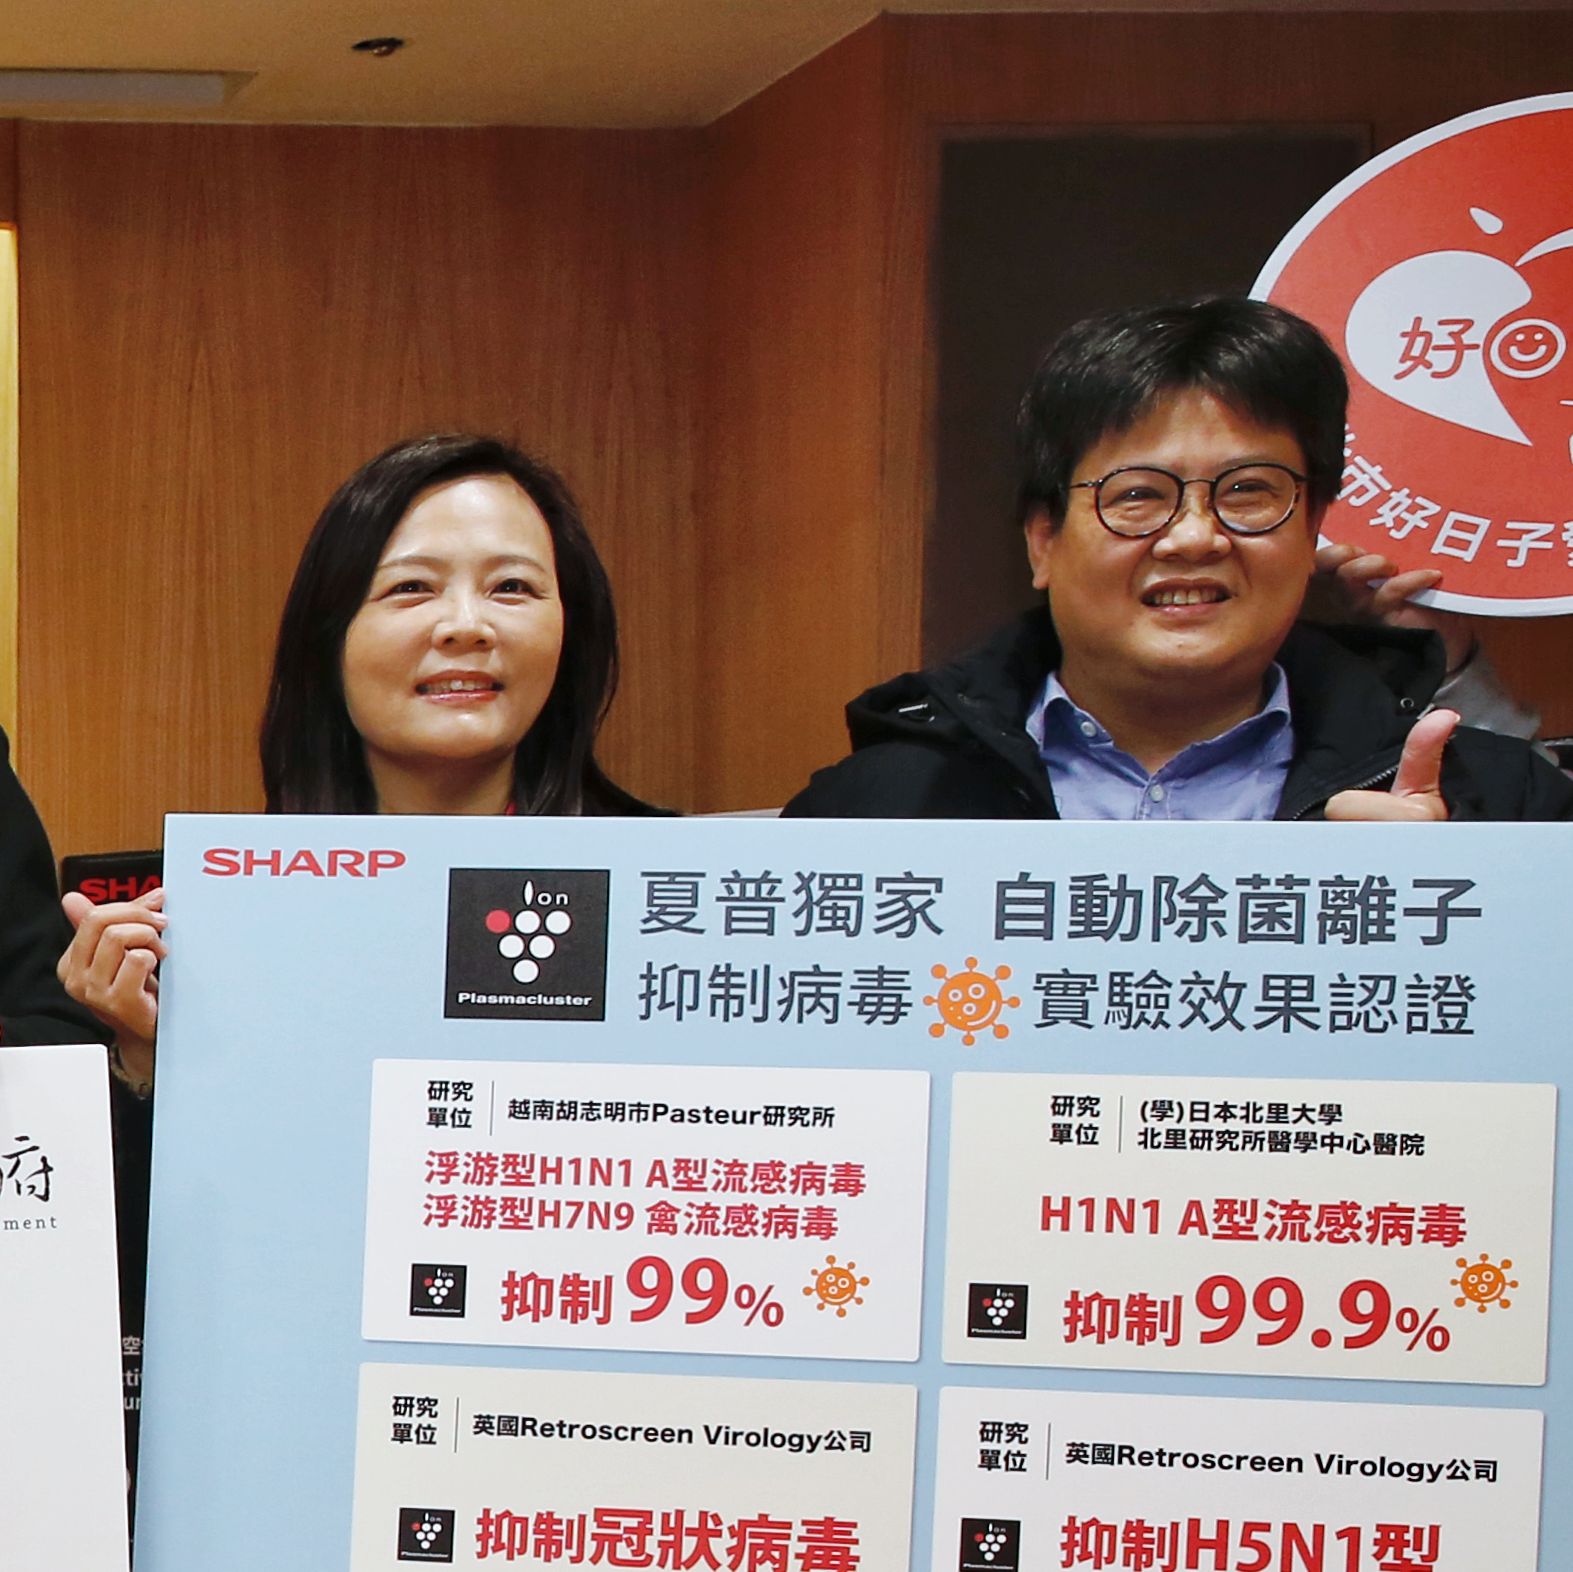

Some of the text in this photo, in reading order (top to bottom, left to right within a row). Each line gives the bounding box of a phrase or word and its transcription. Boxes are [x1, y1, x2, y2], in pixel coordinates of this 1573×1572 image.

[1337, 424, 1573, 568] 市好日子
[202, 848, 407, 878] SHARP
[524, 879, 569, 907] Ion
[640, 869, 1482, 946] 夏普獨家 自動除菌離子
[457, 992, 592, 1008] Plasmacluster
[638, 961, 1477, 1036] 抑制病毒 實驗效果認證
[427, 1080, 474, 1102] 研究
[427, 1107, 472, 1129] 單位
[508, 1098, 835, 1129] 越南胡志明市Pasteur研究所
[1050, 1094, 1101, 1117] 研究
[1140, 1098, 1343, 1126] (學)日本北里大學
[1050, 1123, 1100, 1146] 單位
[1137, 1128, 1426, 1157] 北里研究所醫學中心醫院
[423, 1150, 867, 1199] 浮游型H1N1 A型流感病毒
[422, 1194, 838, 1241] 浮游型H7N9 禽流感病毒
[1041, 1196, 1467, 1248] H1N1 A型流感病毒
[391, 1395, 439, 1419] 研究
[390, 1422, 438, 1446] 單位
[472, 1414, 872, 1453] 英國Retroscreen Virology公司
[978, 1421, 1029, 1445] 研究
[977, 1449, 1028, 1473] 單位
[1065, 1442, 1498, 1483] 英國Retroscreen Virology公司
